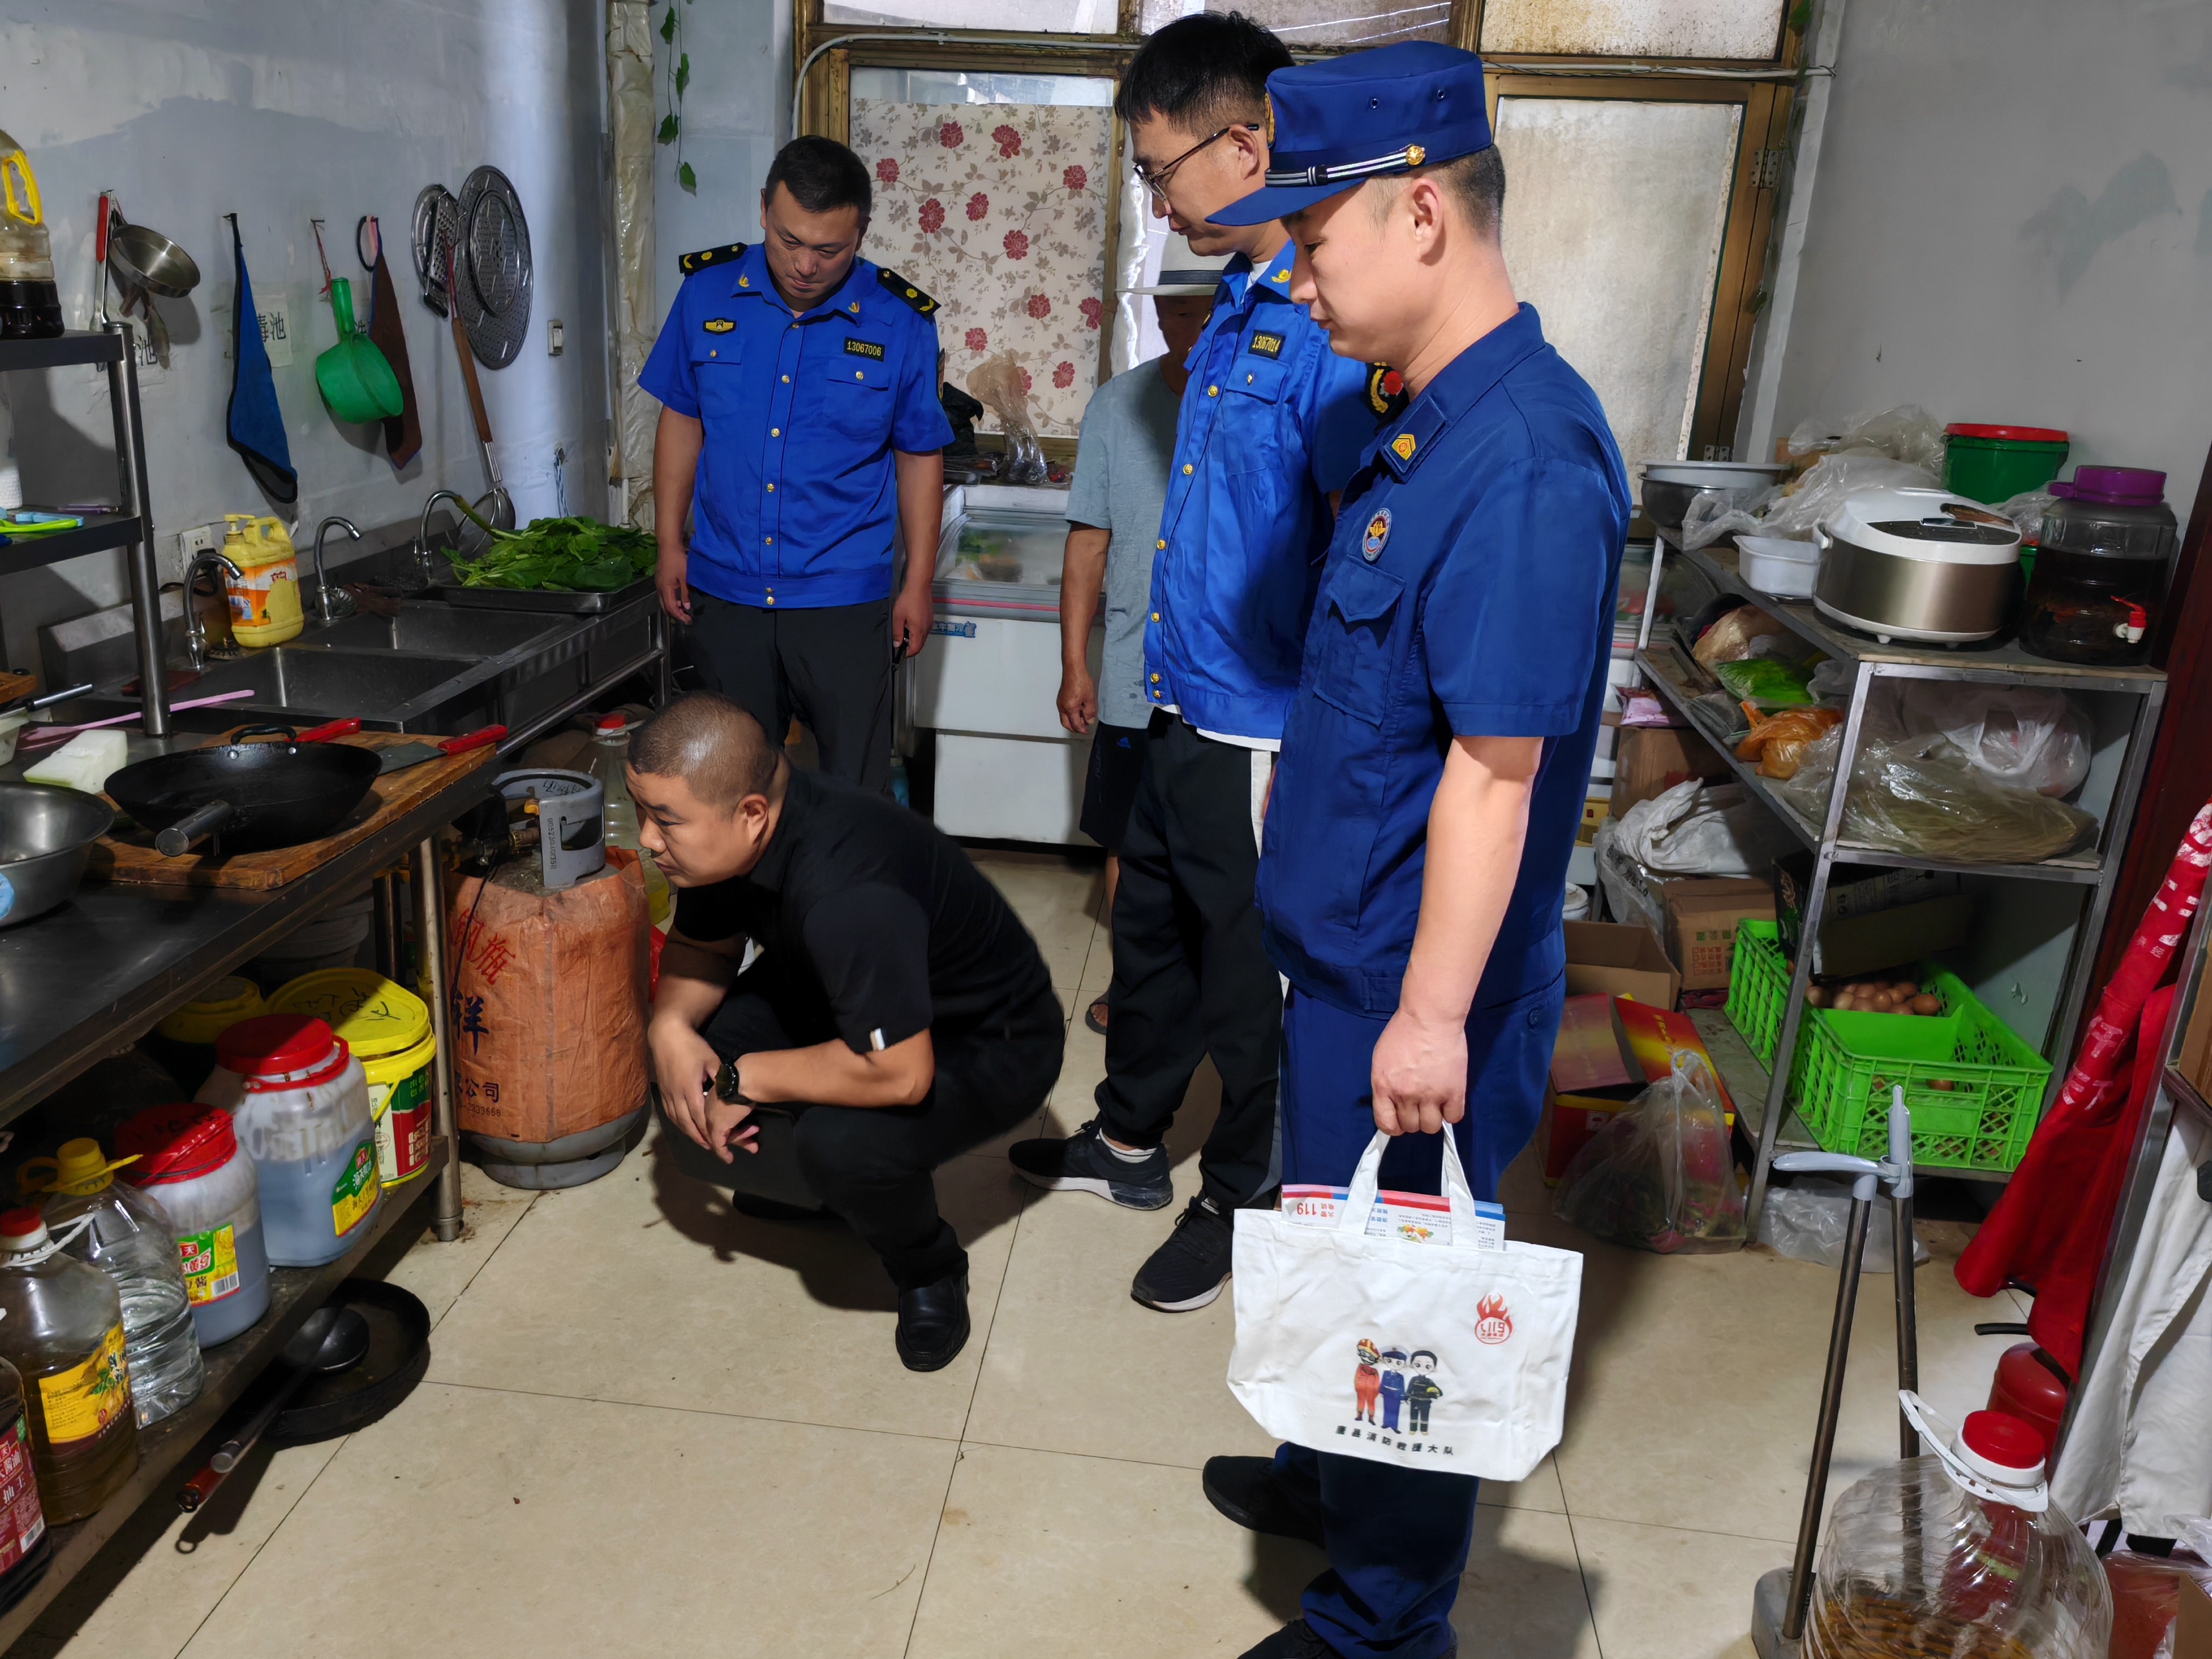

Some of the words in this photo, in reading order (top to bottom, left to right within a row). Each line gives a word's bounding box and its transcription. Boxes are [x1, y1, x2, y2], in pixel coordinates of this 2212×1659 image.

[847, 340, 881, 356] 13067006
[1297, 1203, 1316, 1215] 119
[1488, 1321, 1505, 1333] 119
